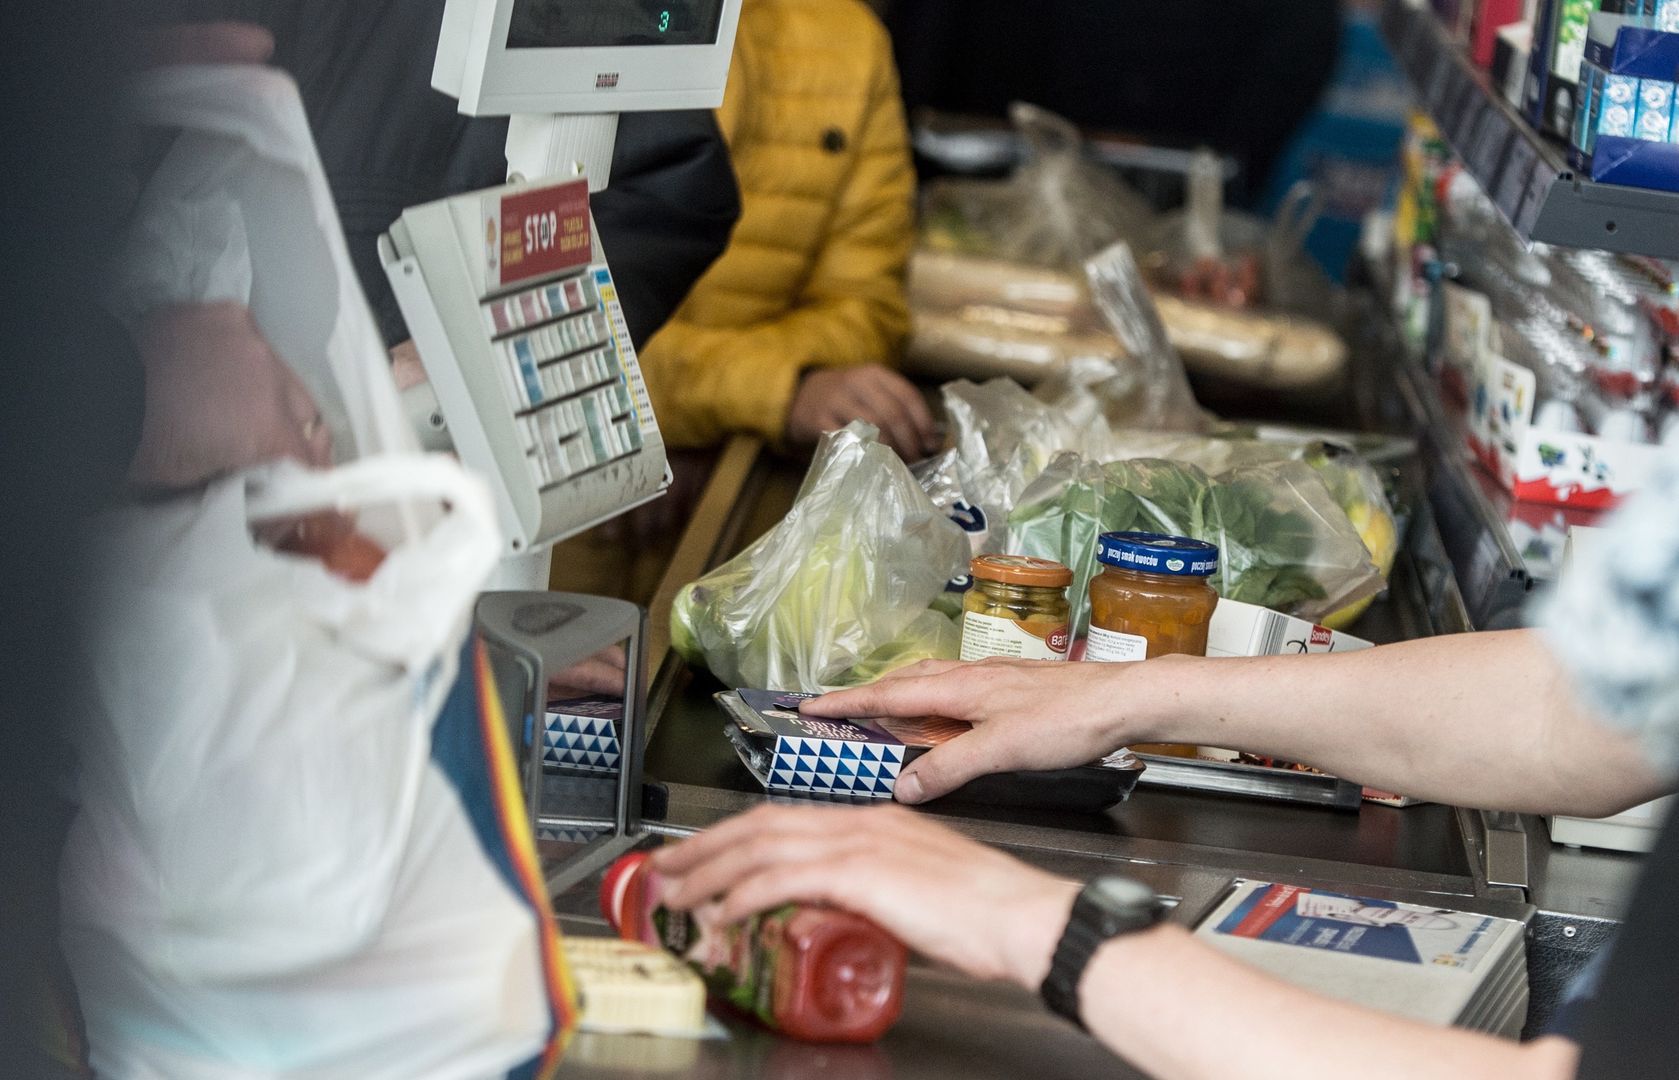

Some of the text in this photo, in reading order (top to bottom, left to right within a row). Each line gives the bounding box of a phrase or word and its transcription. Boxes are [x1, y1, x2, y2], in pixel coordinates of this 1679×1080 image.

[658, 11, 670, 32] 3
[525, 211, 558, 254] STOP
[1107, 547, 1121, 562] poczuj
[1121, 550, 1135, 563] smak
[1135, 554, 1159, 567] owoców
[789, 719, 836, 729] LIDLU
